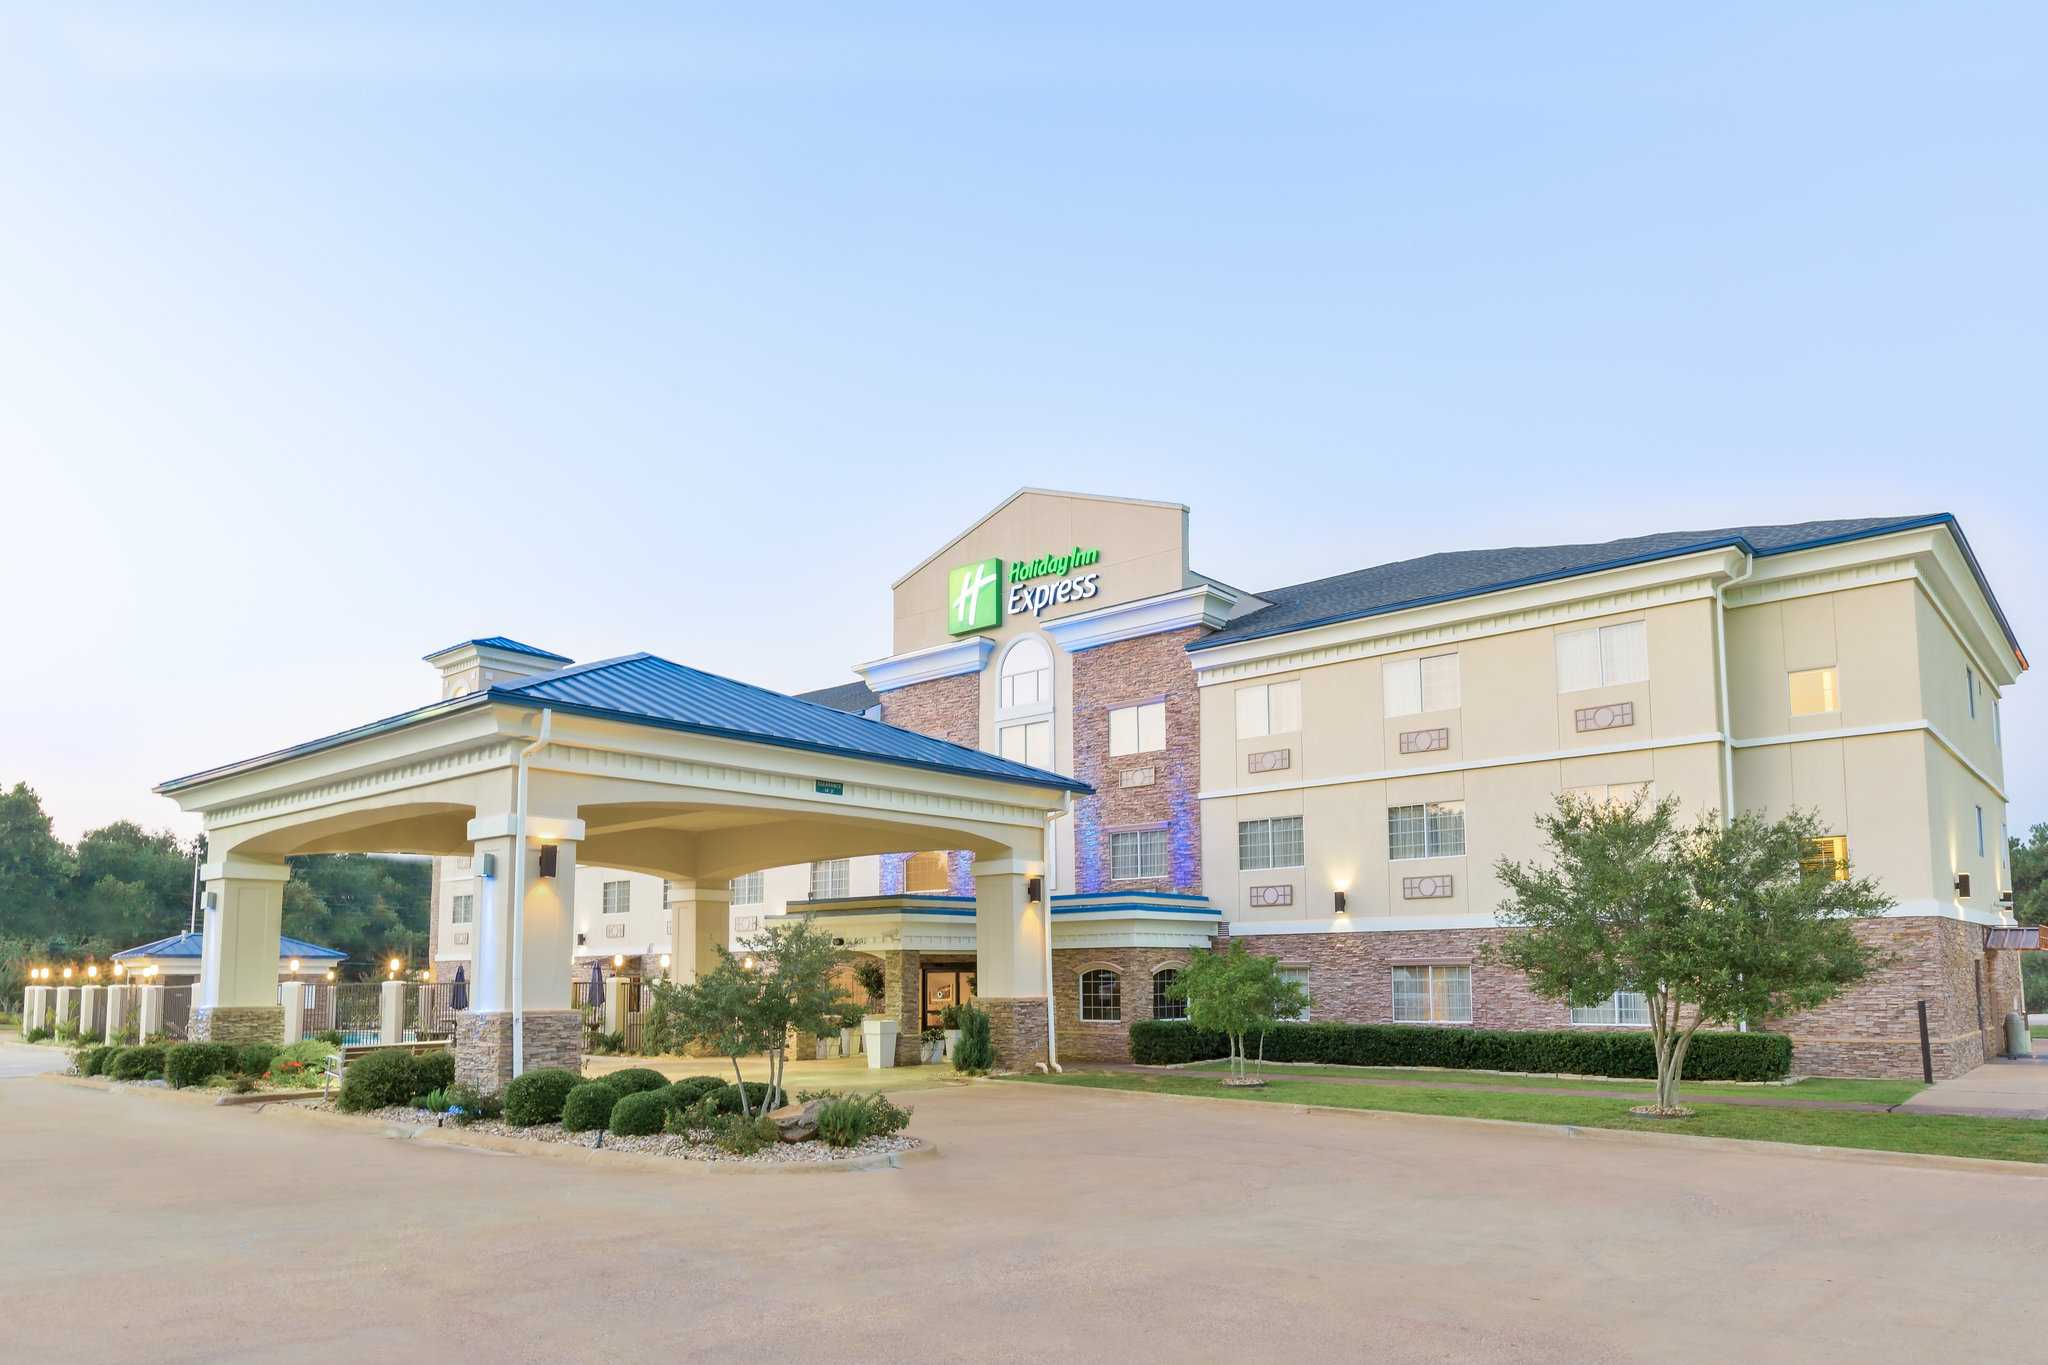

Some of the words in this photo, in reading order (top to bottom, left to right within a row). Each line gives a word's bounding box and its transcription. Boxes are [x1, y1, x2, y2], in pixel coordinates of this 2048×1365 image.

[1008, 555, 1069, 583] Holiday
[1070, 546, 1099, 569] Inn
[1007, 572, 1099, 617] Express
